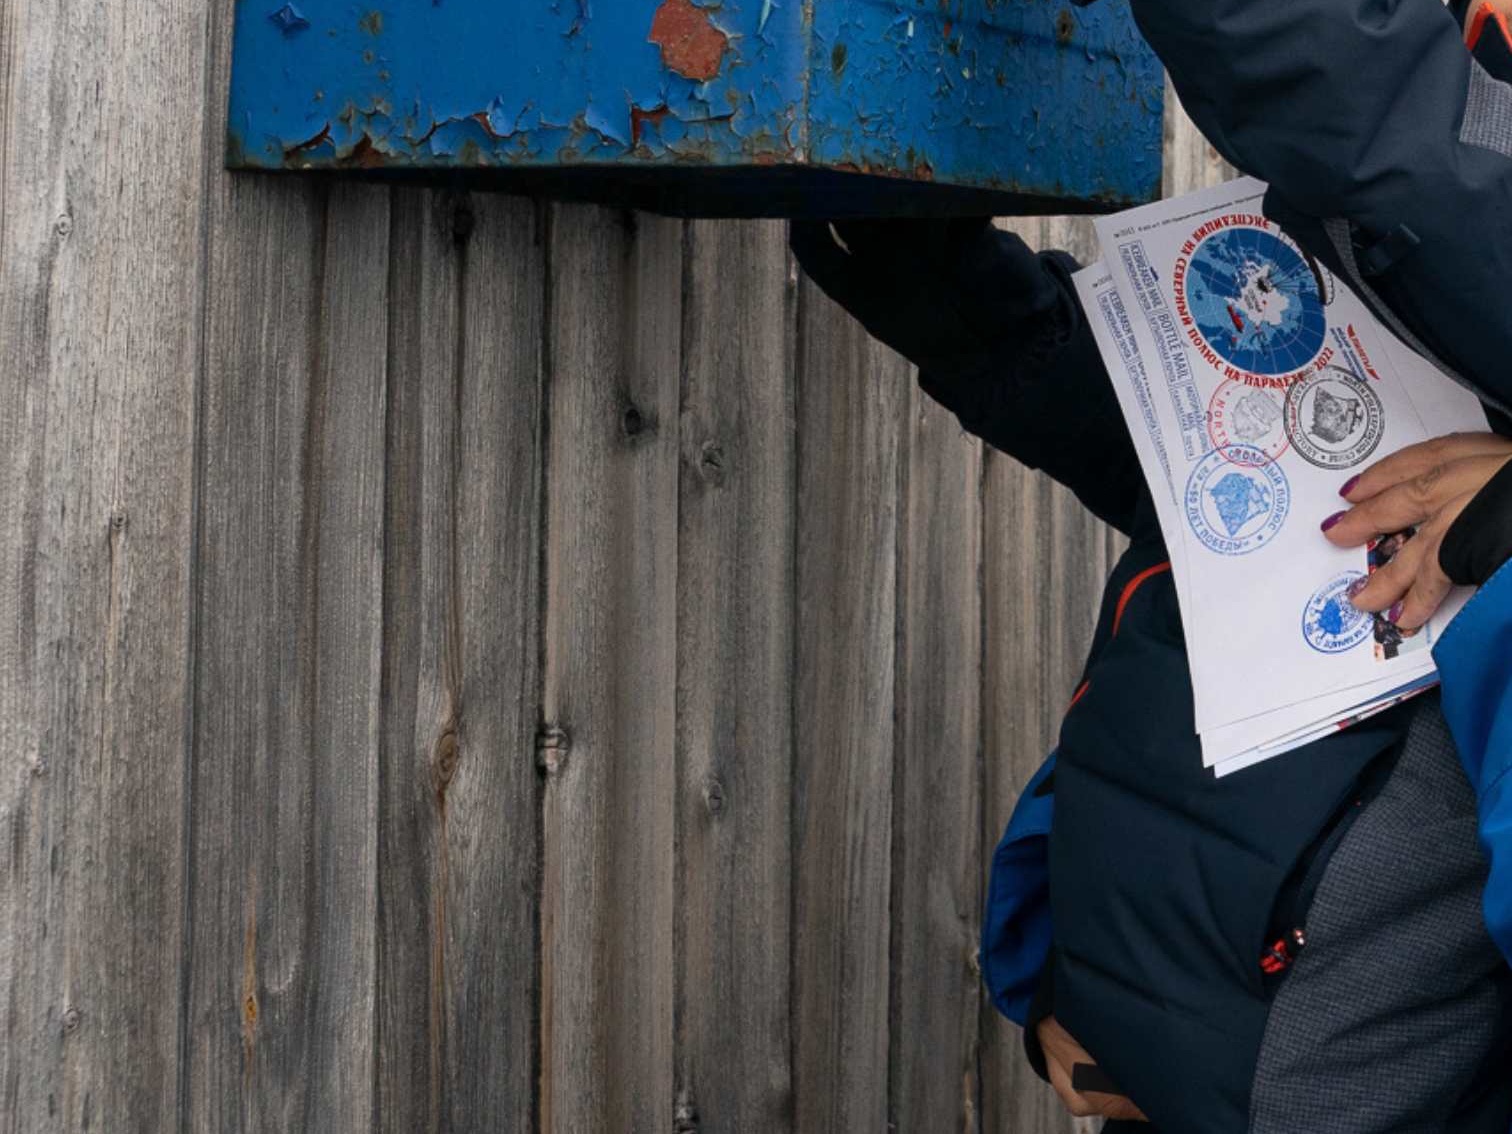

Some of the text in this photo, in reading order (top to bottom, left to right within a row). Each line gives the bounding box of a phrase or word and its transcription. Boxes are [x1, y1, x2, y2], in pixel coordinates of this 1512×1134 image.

[1157, 312, 1190, 380] BOTTLE MAIL
[1173, 257, 1194, 326] СЕВЕРНЫЙ
[1187, 328, 1224, 371] ПОЛЮС
[1224, 366, 1241, 382] НА
[1268, 488, 1286, 531] ПОЛЮС
